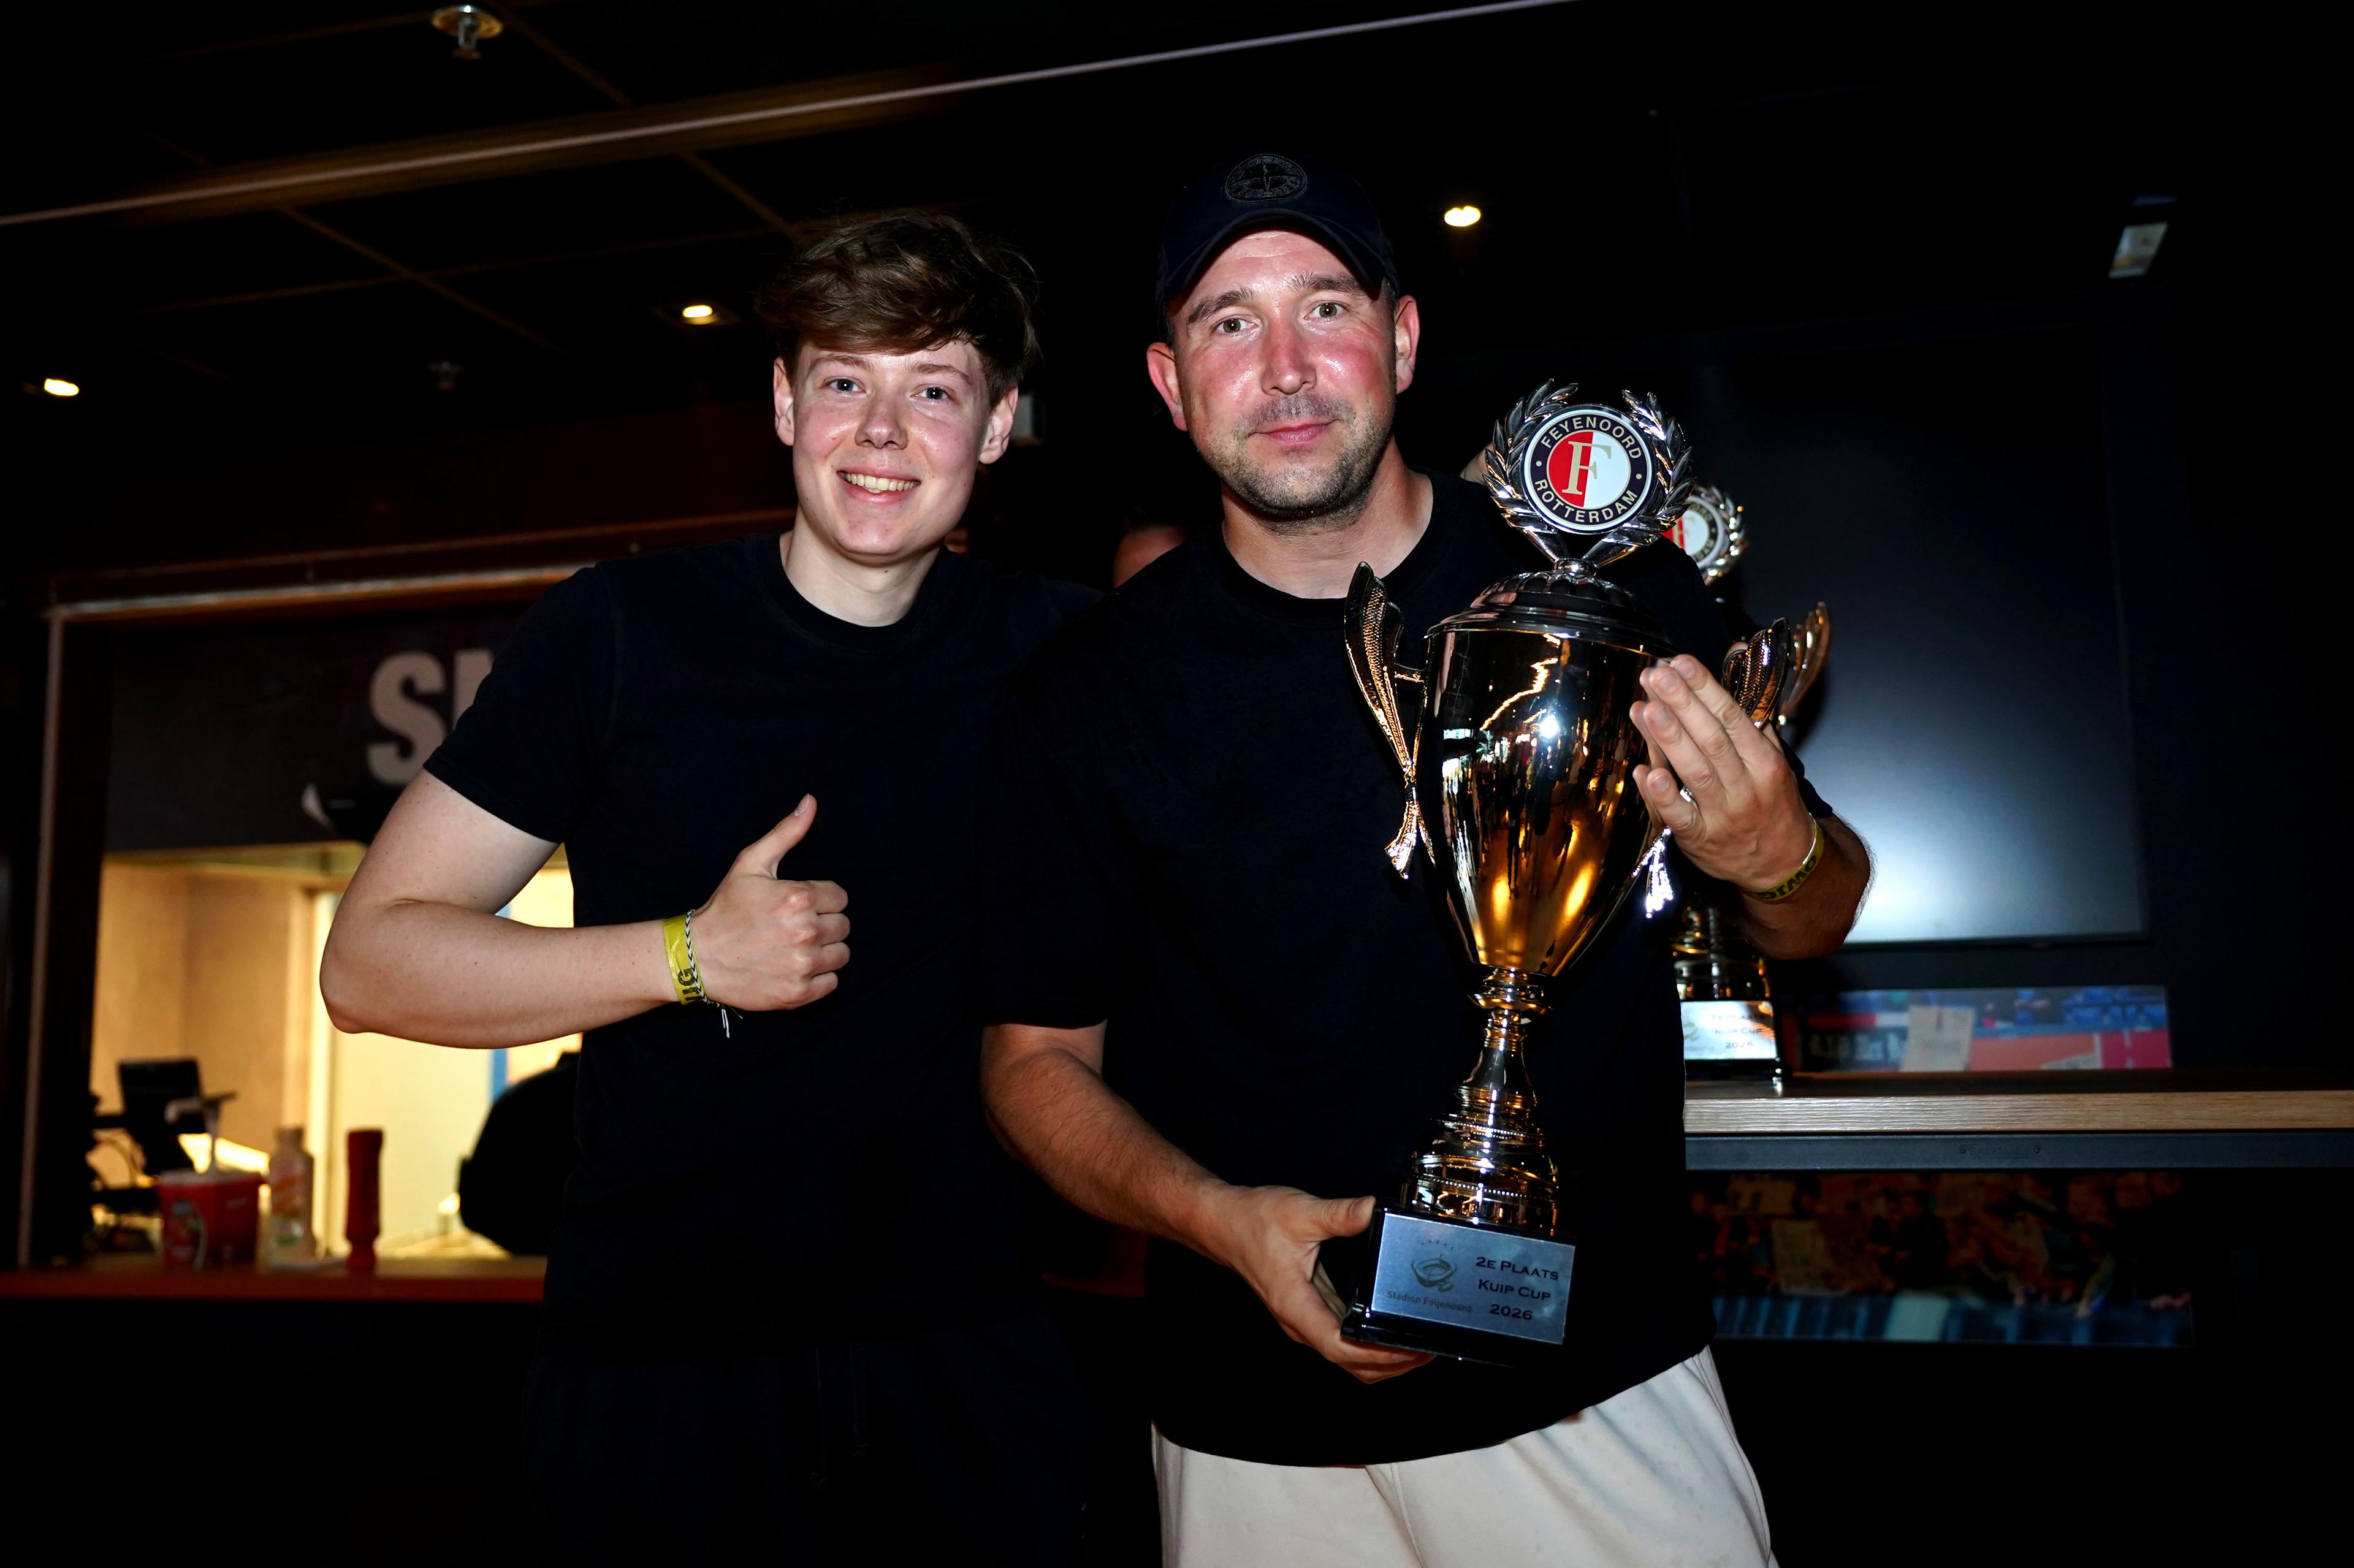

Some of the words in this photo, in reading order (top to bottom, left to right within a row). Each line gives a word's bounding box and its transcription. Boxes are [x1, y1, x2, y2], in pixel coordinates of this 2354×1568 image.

[1541, 416, 1642, 459] FEYENOORD
[1561, 440, 1612, 495] F
[1535, 479, 1637, 523] ROTTERDAM
[1489, 1303, 1533, 1320] 2026
